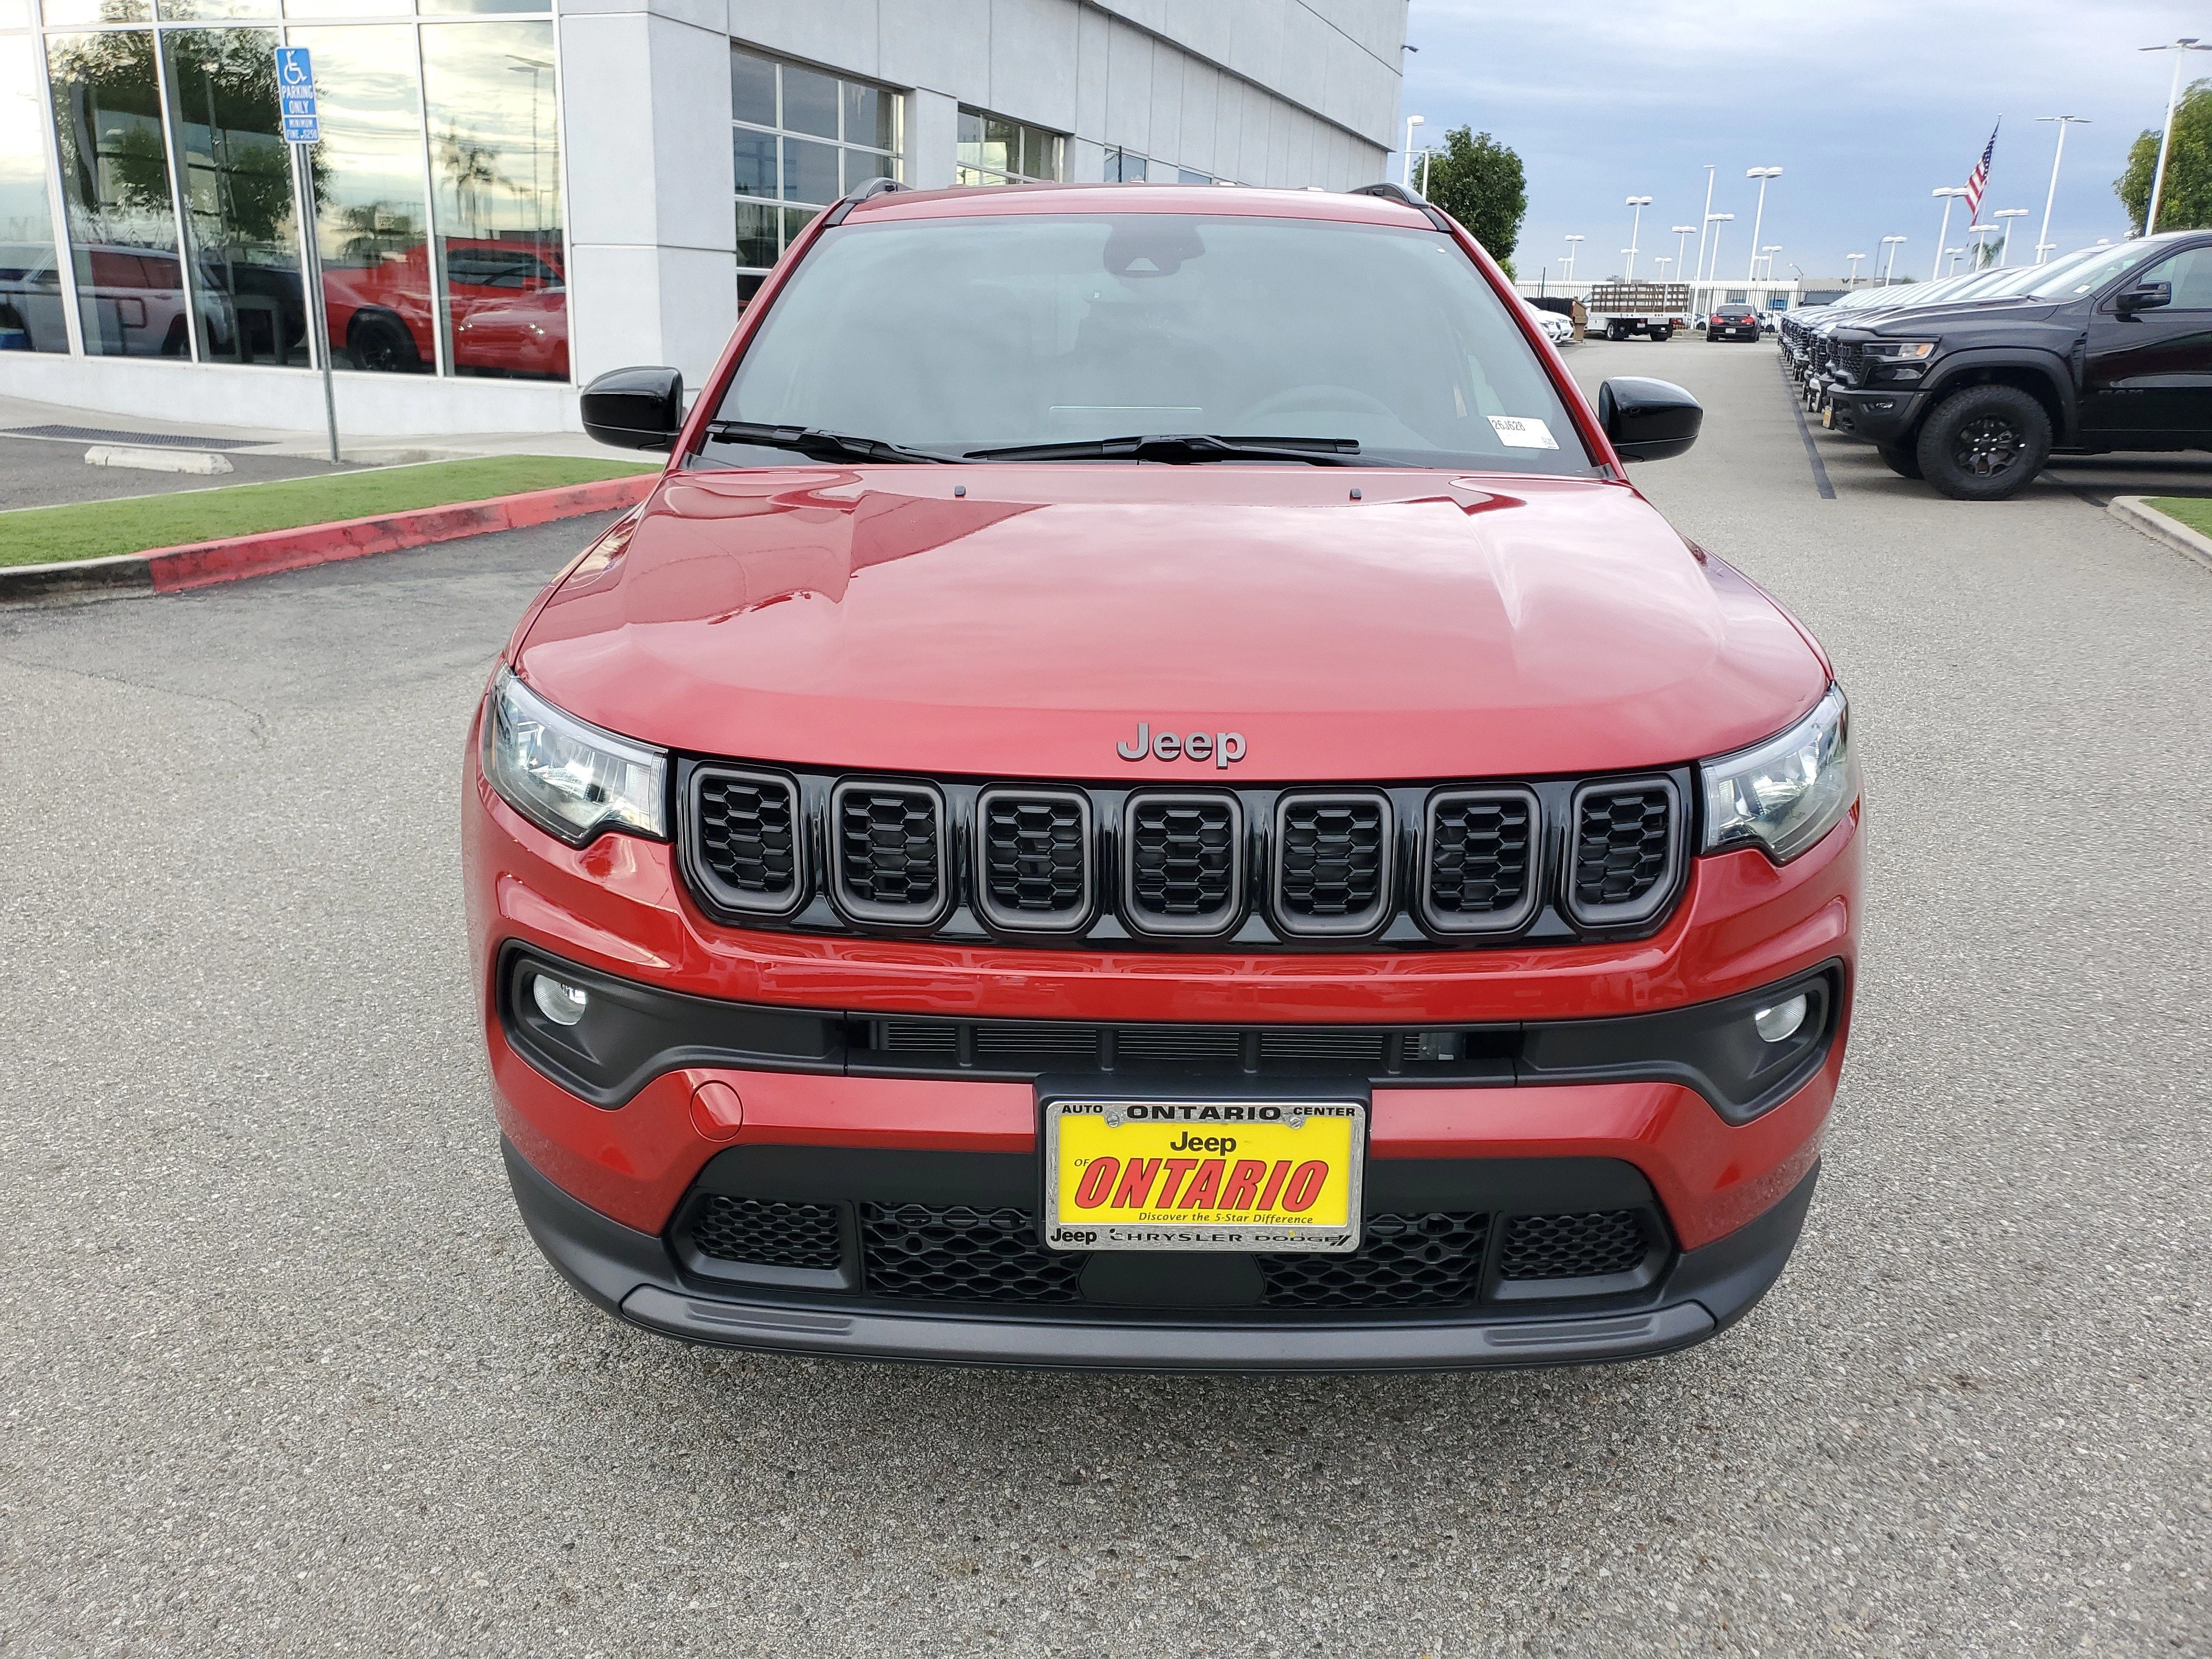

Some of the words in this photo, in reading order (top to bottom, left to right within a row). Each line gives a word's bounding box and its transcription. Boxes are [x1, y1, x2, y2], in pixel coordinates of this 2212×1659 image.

[281, 85, 313, 99] PARKING
[289, 100, 309, 114] ONLY
[1492, 420, 1526, 431] 26J628
[1116, 723, 1247, 770] Jeep
[1062, 1104, 1104, 1114] AUTO
[1126, 1105, 1281, 1120] ONTARIO
[1293, 1107, 1356, 1117] CENTER
[1170, 1131, 1237, 1156] Jeep
[1074, 1159, 1090, 1167] OF
[1074, 1156, 1329, 1212] ONTARIO
[1138, 1211, 1188, 1222] Discover
[1192, 1212, 1210, 1222] the
[1215, 1214, 1249, 1223] 5-Star
[1253, 1215, 1313, 1224] Difference
[1050, 1228, 1098, 1245] Jeep
[1110, 1233, 1243, 1242] CHRYSLER
